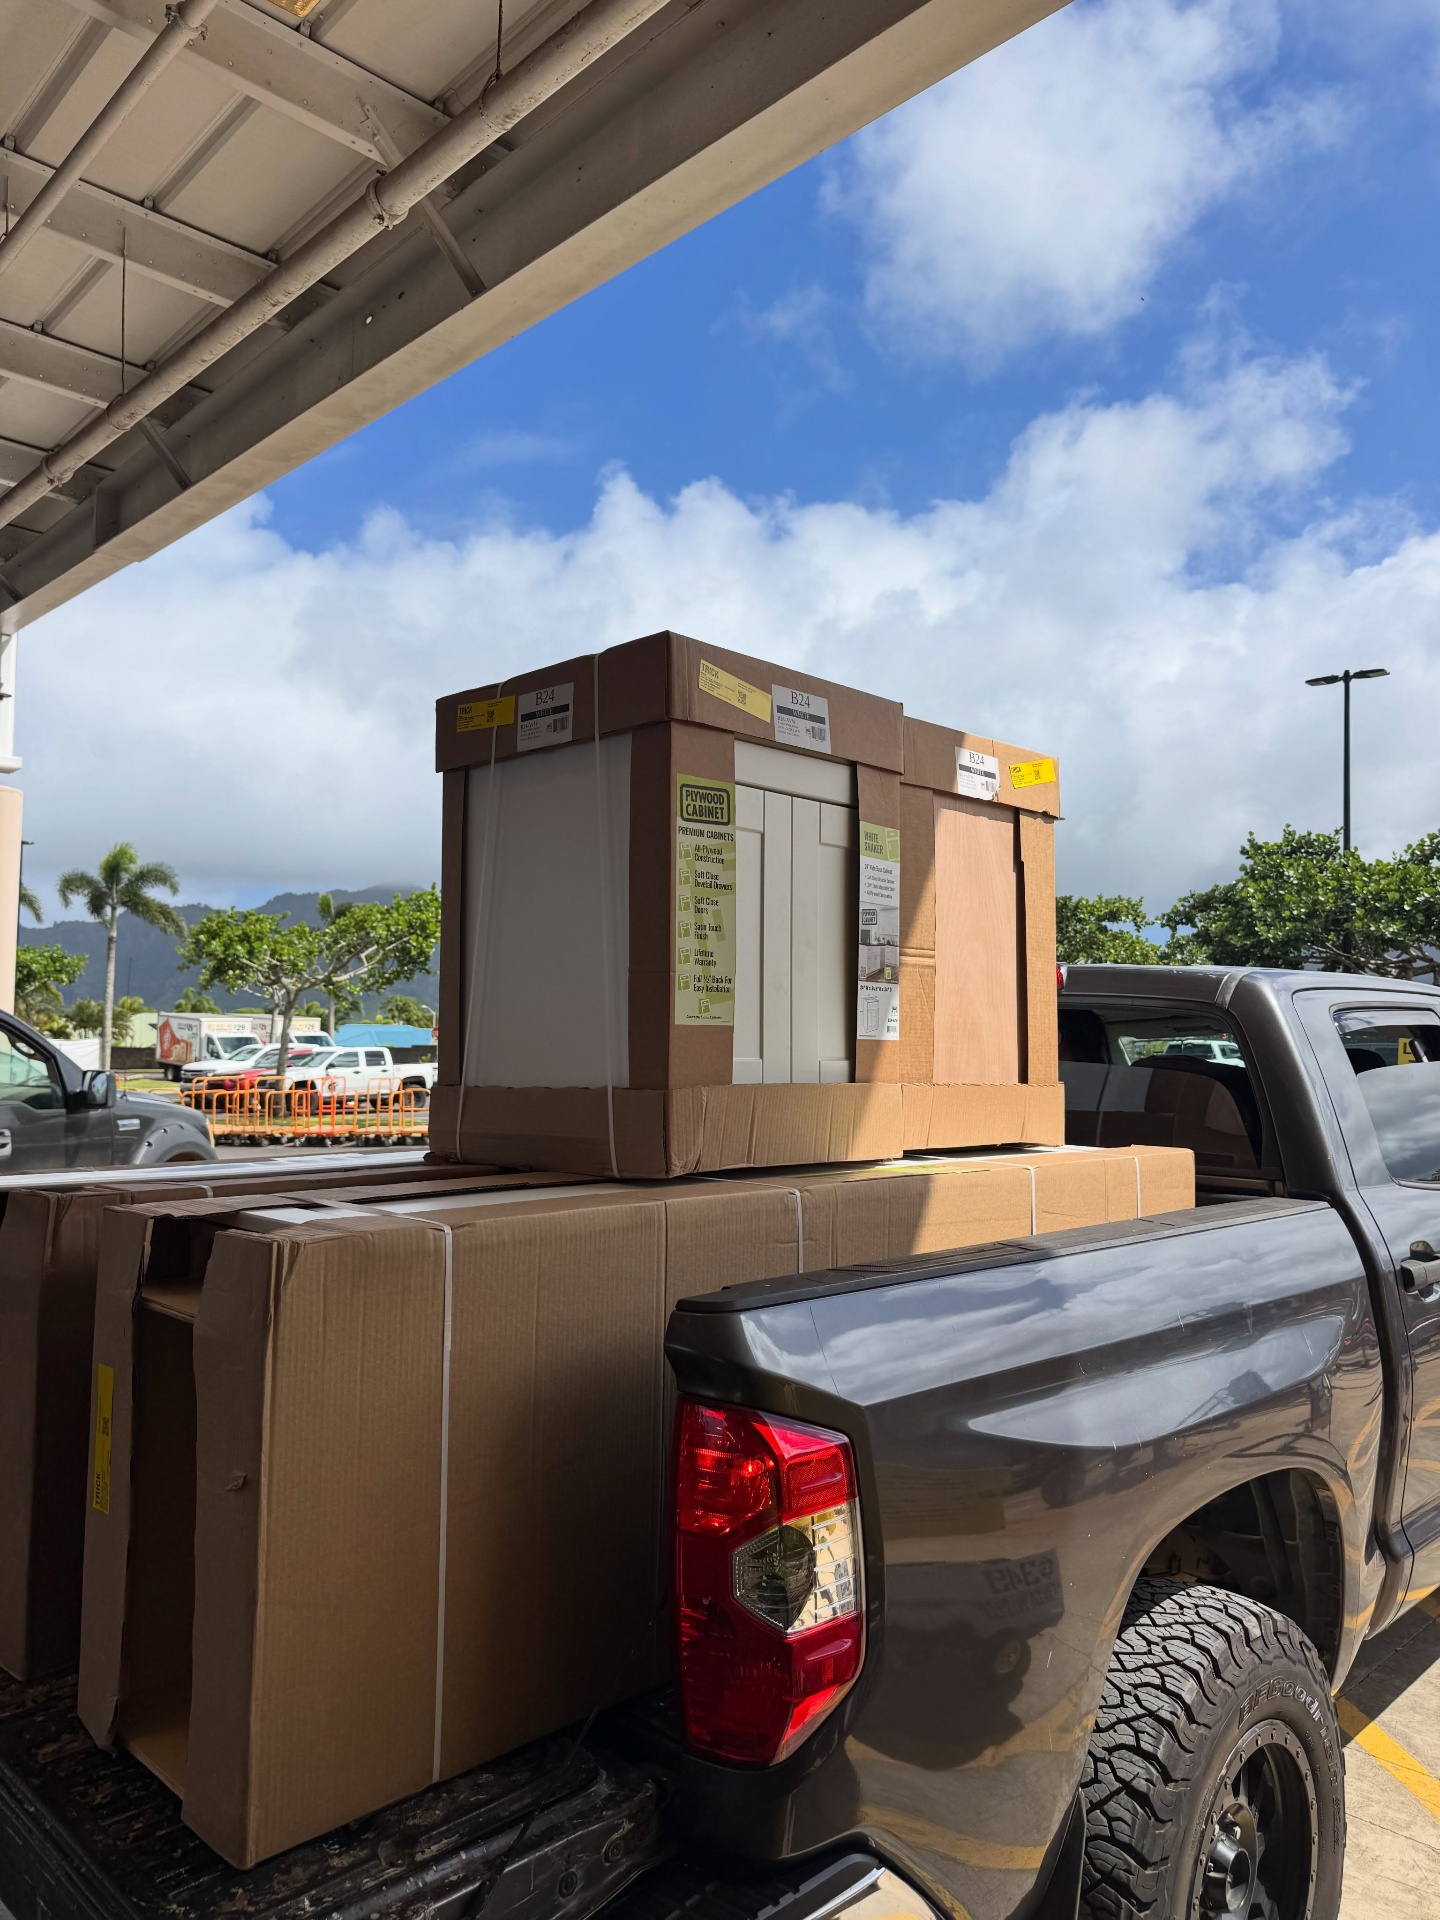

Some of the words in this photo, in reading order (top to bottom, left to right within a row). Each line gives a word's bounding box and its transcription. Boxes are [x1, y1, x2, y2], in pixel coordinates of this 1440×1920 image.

[701, 662, 719, 679] TRICK
[535, 689, 555, 706] B24
[790, 690, 811, 708] B24
[458, 706, 473, 715] TRICK
[535, 708, 554, 718] WHITE
[969, 751, 985, 766] B24
[685, 790, 724, 805] PLYWOOD
[685, 803, 724, 820] CABINET
[678, 826, 705, 837] PREMIUM
[706, 830, 734, 841] CABINETS
[864, 831, 879, 843] WHITE
[694, 844, 723, 855] All-Plywood
[864, 842, 884, 854] SHAKER
[694, 853, 725, 864] Construction
[694, 870, 705, 879] Soft
[705, 871, 719, 880] Close
[694, 879, 713, 888] Dovetail
[713, 881, 733, 891] Drawers
[694, 896, 705, 905] Soft
[705, 897, 719, 906] Close
[694, 905, 709, 914] Doors
[694, 922, 707, 931] Satin
[708, 923, 722, 932] Touch
[694, 931, 709, 940] Finish
[694, 948, 715, 957] Lifetime
[694, 957, 717, 968] Warranty
[693, 974, 703, 983] Full
[711, 975, 724, 984] Back
[724, 976, 732, 984] For
[693, 984, 705, 993] Easy
[705, 984, 730, 993] Installation
[94, 1473, 102, 1505] TRICK
[1238, 1675, 1338, 1786] BFGoodrich
